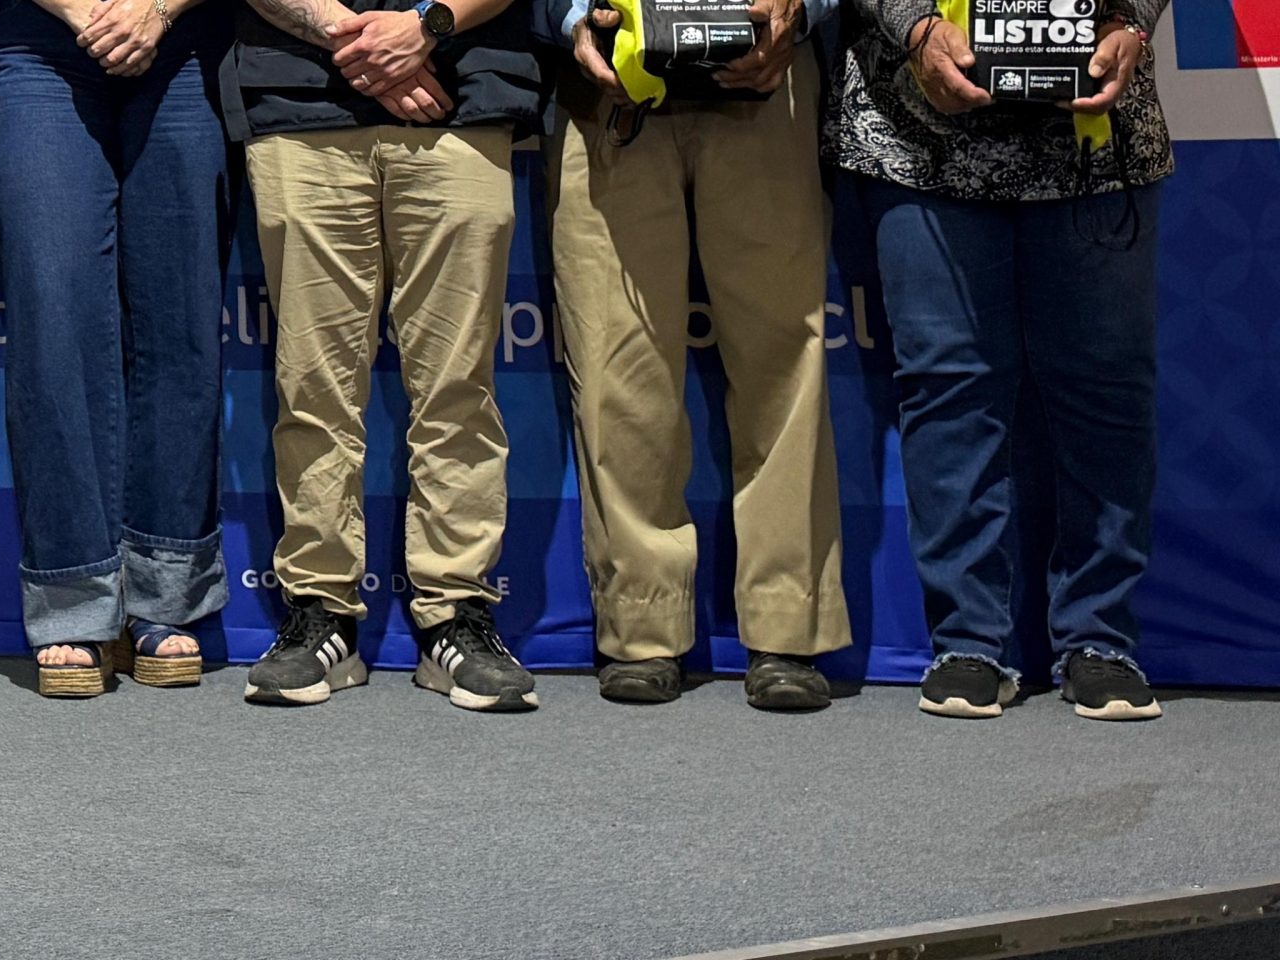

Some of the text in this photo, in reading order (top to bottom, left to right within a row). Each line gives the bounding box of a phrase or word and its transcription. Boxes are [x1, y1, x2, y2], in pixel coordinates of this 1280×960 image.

[975, 0, 1048, 14] SIEMPRE
[974, 18, 1096, 44] LISTOS
[974, 44, 1095, 54] Energía para estar conectados
